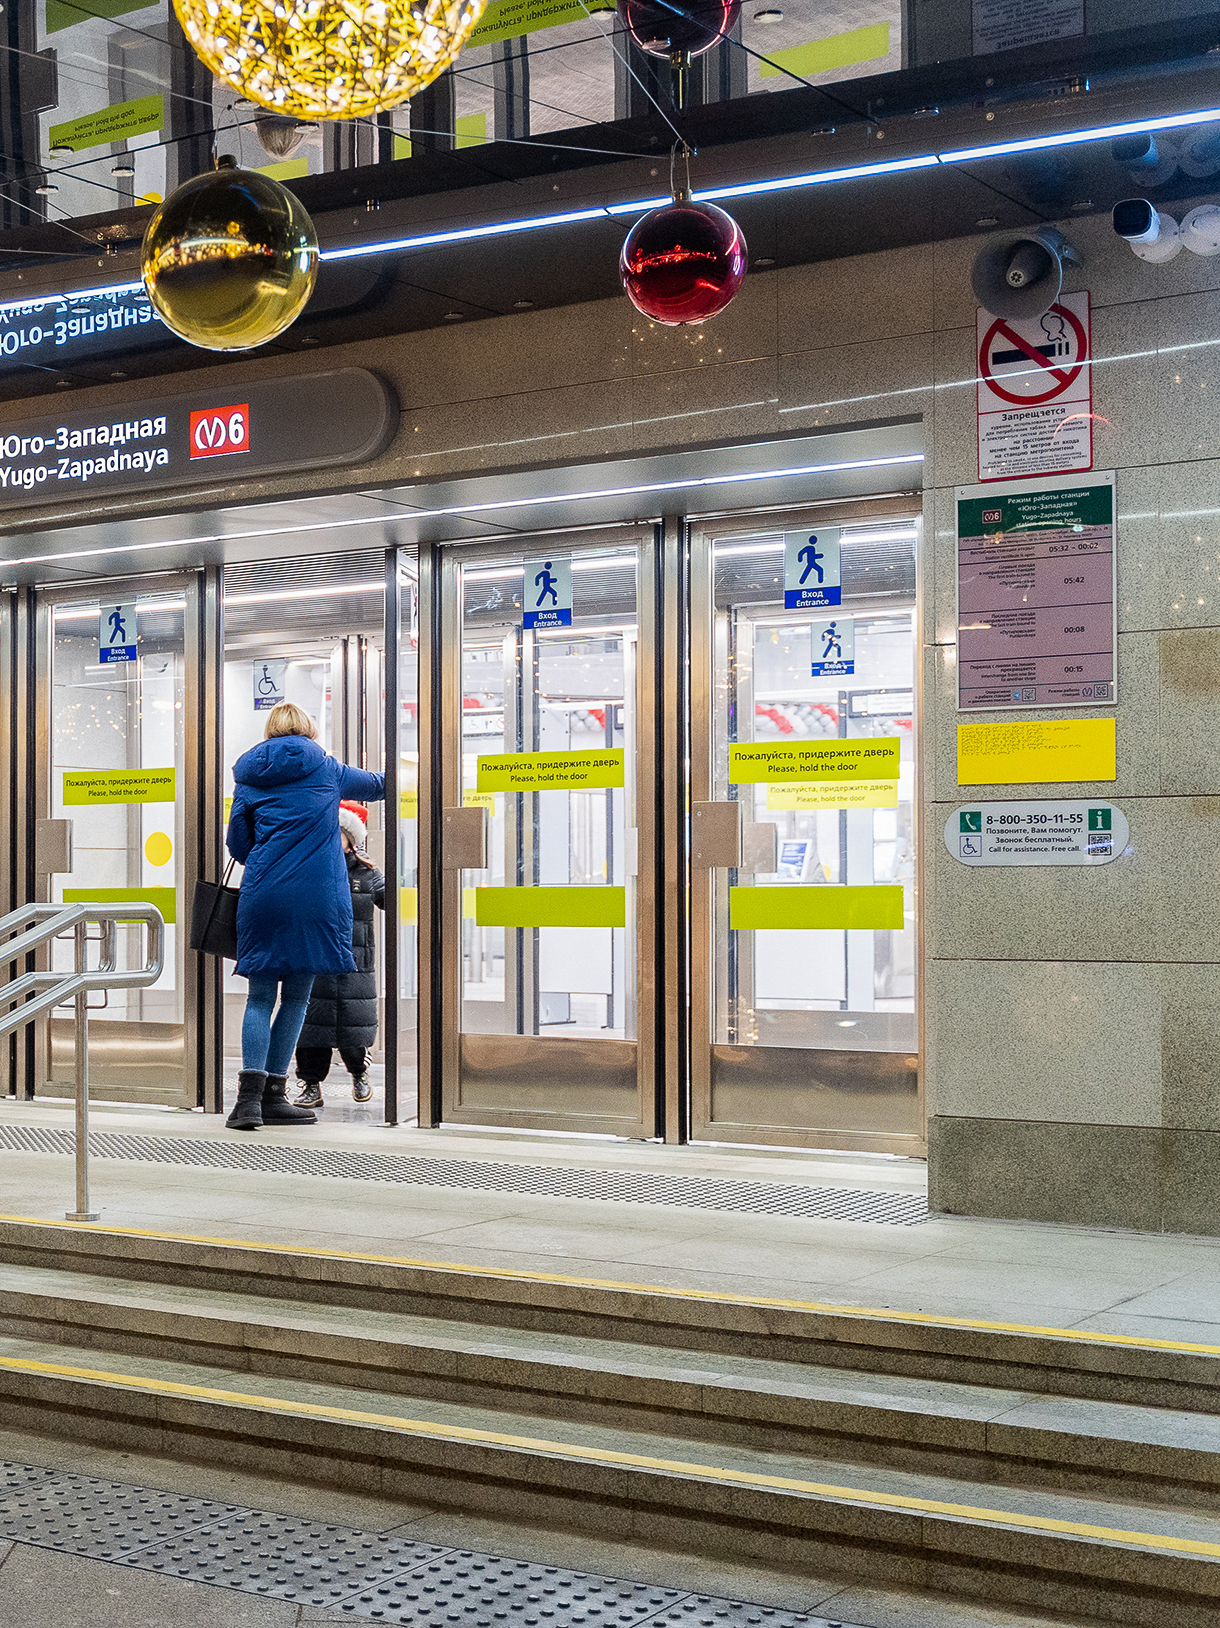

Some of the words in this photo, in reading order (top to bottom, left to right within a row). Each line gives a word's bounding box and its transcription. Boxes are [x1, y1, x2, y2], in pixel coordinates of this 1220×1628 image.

[1007, 496, 1031, 505] Режим
[1033, 493, 1059, 503] работы
[1061, 491, 1090, 500] станции
[1021, 509, 1074, 522] Yugo-Zapadnaya
[1049, 545, 1068, 553] 05:32
[802, 590, 824, 599] Вход
[796, 598, 829, 607] Entrance
[538, 612, 558, 620] Вход
[107, 654, 129, 662] Entrance
[735, 750, 796, 763] Пожалуйста,
[798, 750, 861, 760] придержите
[864, 749, 895, 758] дверь
[481, 761, 535, 773] Пожалуйста,
[537, 760, 591, 771] придержите
[592, 759, 619, 769] дверь
[768, 764, 798, 774] Please,
[800, 764, 819, 772] hold
[821, 763, 835, 772] the
[837, 762, 858, 771] door
[66, 778, 107, 788] Пожалуйста,
[108, 777, 150, 786] придержите
[151, 776, 171, 785] дверь
[511, 774, 536, 783] Please,
[538, 774, 554, 782] hold
[556, 773, 569, 781] the
[570, 772, 588, 780] door
[770, 785, 818, 794] Пожалуйста,
[820, 785, 868, 793] придержите
[986, 814, 1083, 825] 8-800-350-11-55
[986, 827, 1029, 835] Позвоните,
[996, 836, 1023, 844] Звонок
[1024, 835, 1074, 843] бесплатный.
